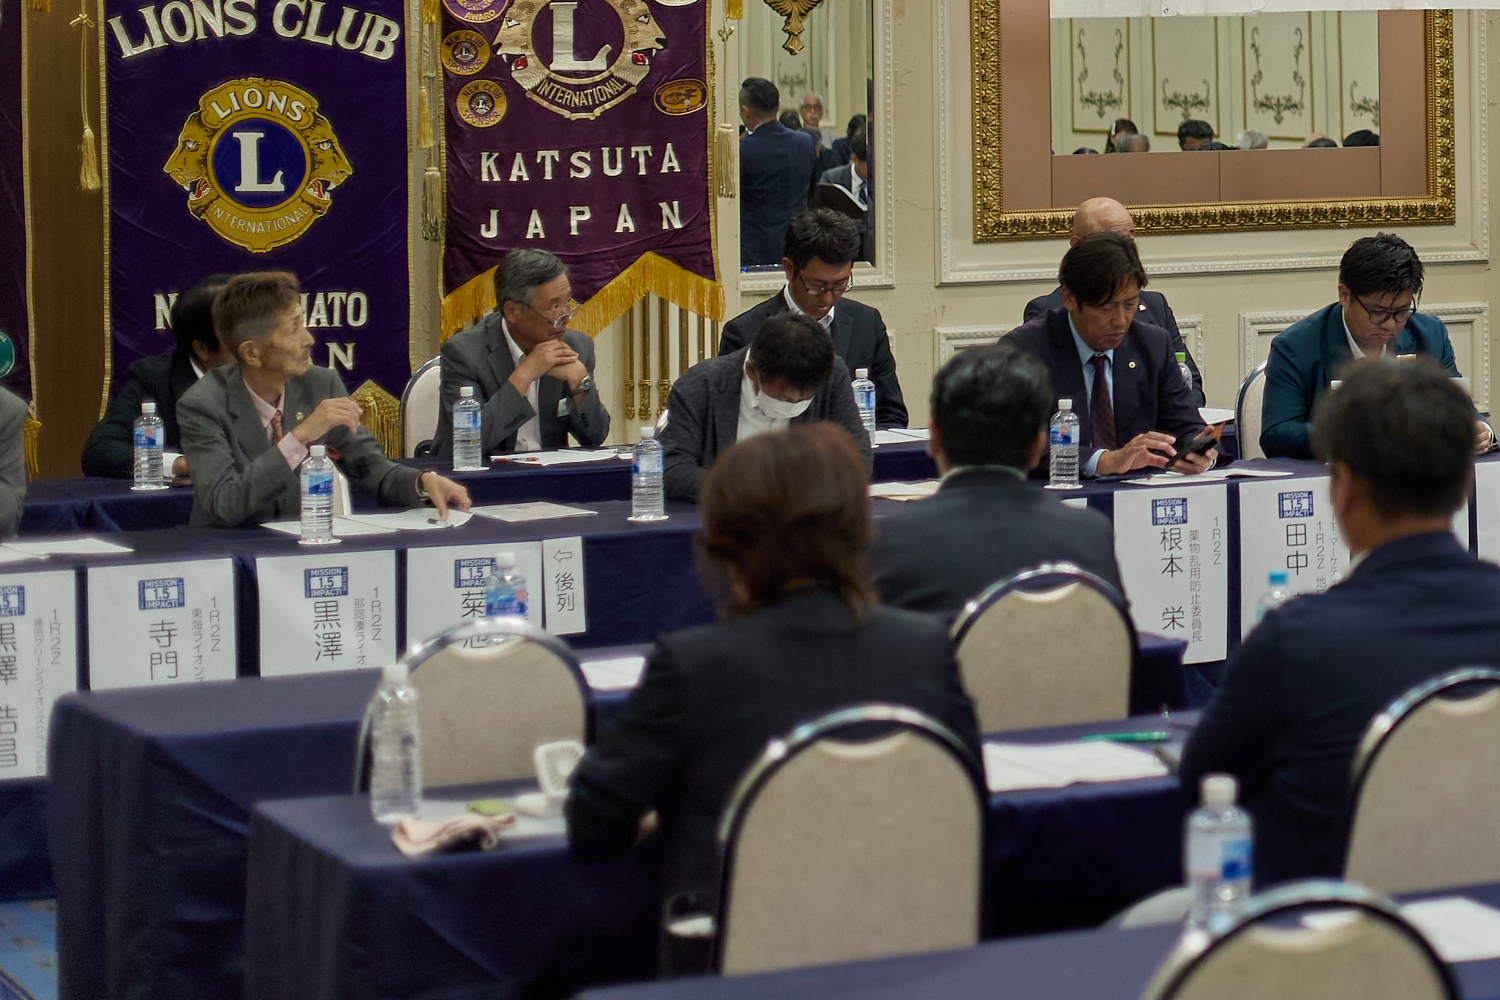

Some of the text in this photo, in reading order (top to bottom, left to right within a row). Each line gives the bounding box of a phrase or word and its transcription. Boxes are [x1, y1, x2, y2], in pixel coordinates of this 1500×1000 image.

[464, 9, 496, 21] AWARD
[445, 33, 485, 48] NEW CLUB
[549, 1, 612, 71] L
[445, 58, 485, 73] SPONSOR
[210, 88, 306, 122] LIONS
[463, 83, 502, 99] NEW CLUB
[536, 77, 627, 107] INTERNATIONAL
[461, 109, 501, 125] SPONSOR
[232, 132, 285, 192] L
[480, 142, 681, 182] KATSUTA
[209, 204, 311, 234] INTERNATIONAL
[480, 200, 683, 239] JAPAN
[1163, 506, 1177, 517] 1.5
[1289, 500, 1303, 510] 1.5
[1212, 516, 1221, 565] 1R2Z
[1286, 523, 1308, 575] 田中
[1315, 521, 1325, 569] 1R2Z
[310, 568, 341, 577] MISSION
[461, 558, 491, 567] MISSION
[468, 567, 484, 579] 1.5
[1160, 527, 1185, 630] 根本 栄
[144, 578, 177, 588] MISSION
[153, 588, 170, 600] 1.5
[318, 576, 334, 589] 1.5
[461, 579, 487, 587] IMPAC
[555, 571, 575, 613] 後列
[1188, 529, 1202, 643] 薬物乱用防止委員長
[209, 596, 221, 652] 1R2Z
[313, 600, 343, 661] 黒澤
[371, 587, 382, 641] 1R2Z
[50, 609, 61, 665] 1R2Z
[148, 620, 178, 680] 寺門
[354, 597, 366, 670] 那珂湊ライオ
